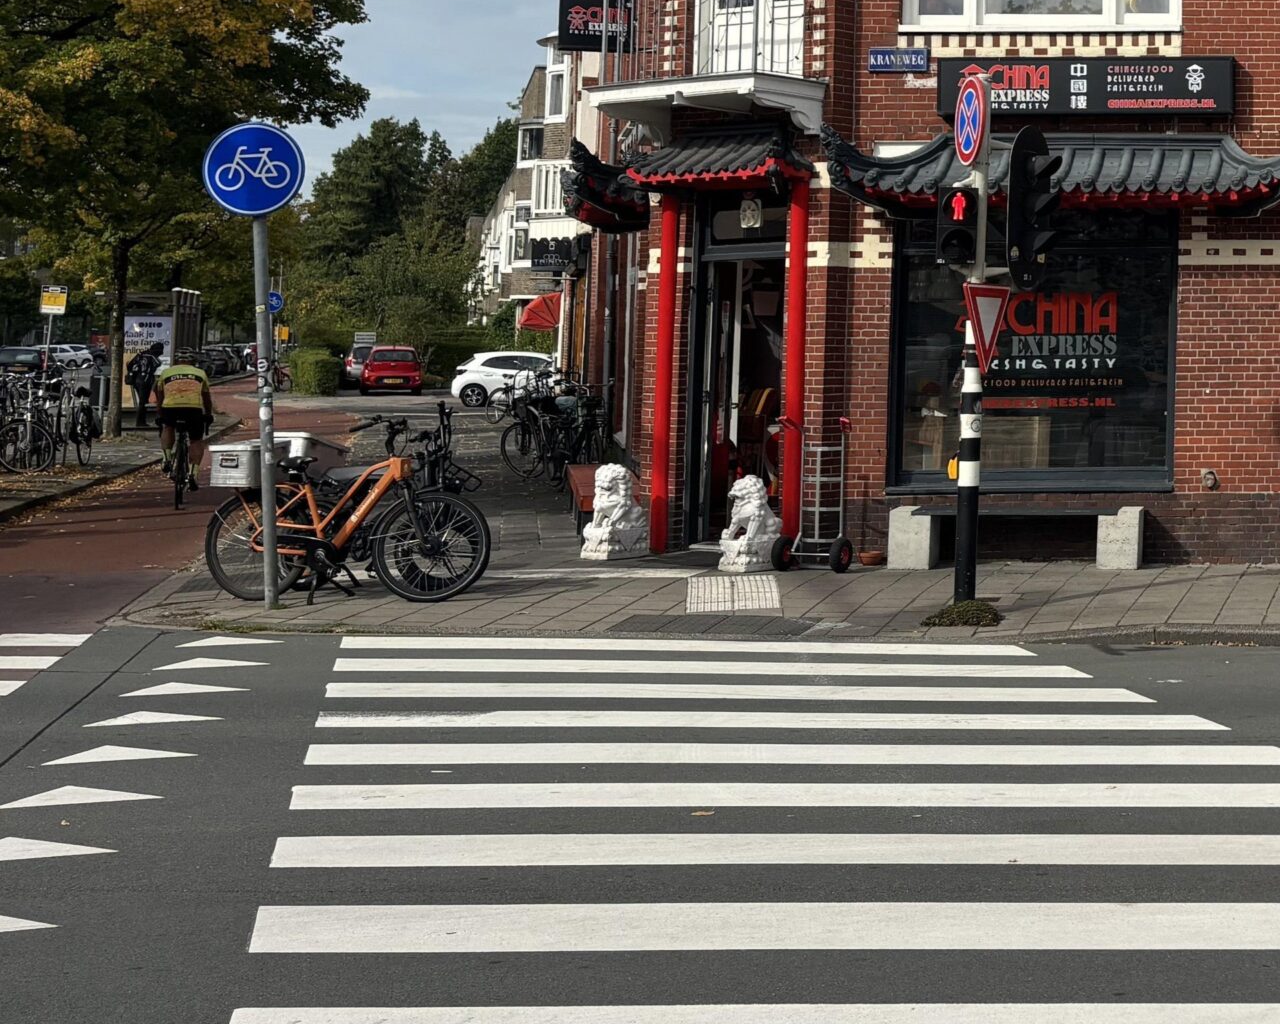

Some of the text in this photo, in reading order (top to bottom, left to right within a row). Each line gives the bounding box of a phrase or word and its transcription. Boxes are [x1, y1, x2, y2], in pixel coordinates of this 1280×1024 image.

[870, 54, 924, 65] KRANEWEG
[987, 64, 1050, 89] CHINA
[1107, 65, 1174, 73] CHINESE FOOD
[991, 89, 1050, 102] EXPRESS
[1007, 291, 1118, 335] CHINA
[1011, 335, 1118, 356] EXPRESS
